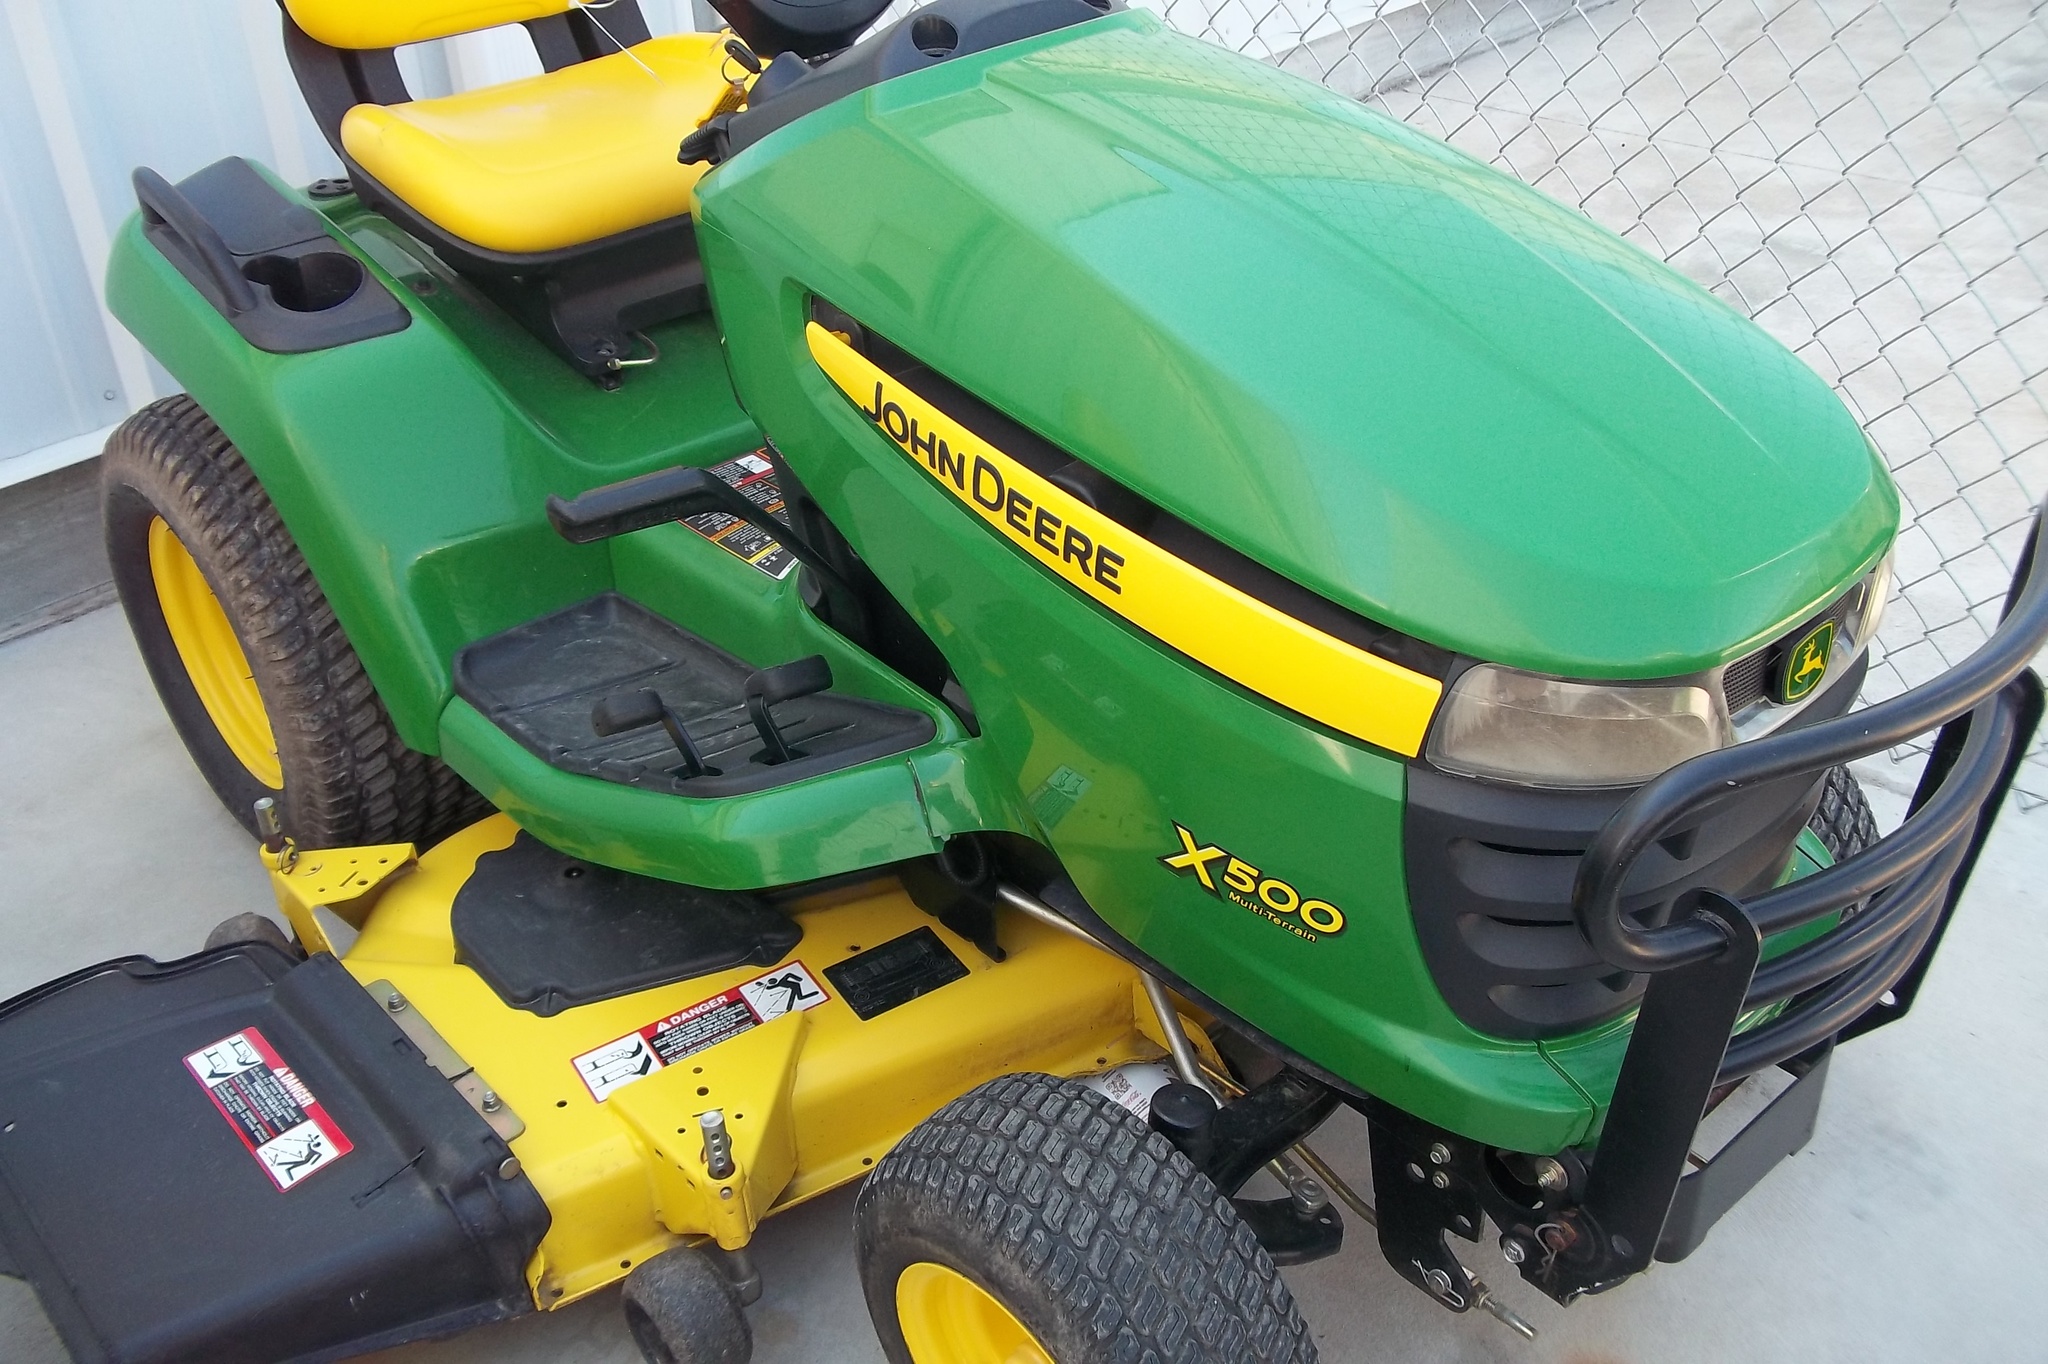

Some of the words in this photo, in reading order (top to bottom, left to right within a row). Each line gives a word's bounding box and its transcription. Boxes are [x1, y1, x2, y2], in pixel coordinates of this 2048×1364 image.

[863, 381, 965, 490] JOHN
[972, 455, 1125, 595] DEERE
[1160, 822, 1345, 935] X500
[1228, 891, 1317, 943] Multi-Terrain
[670, 995, 728, 1025] DANGER
[281, 1072, 317, 1109] DANGER
